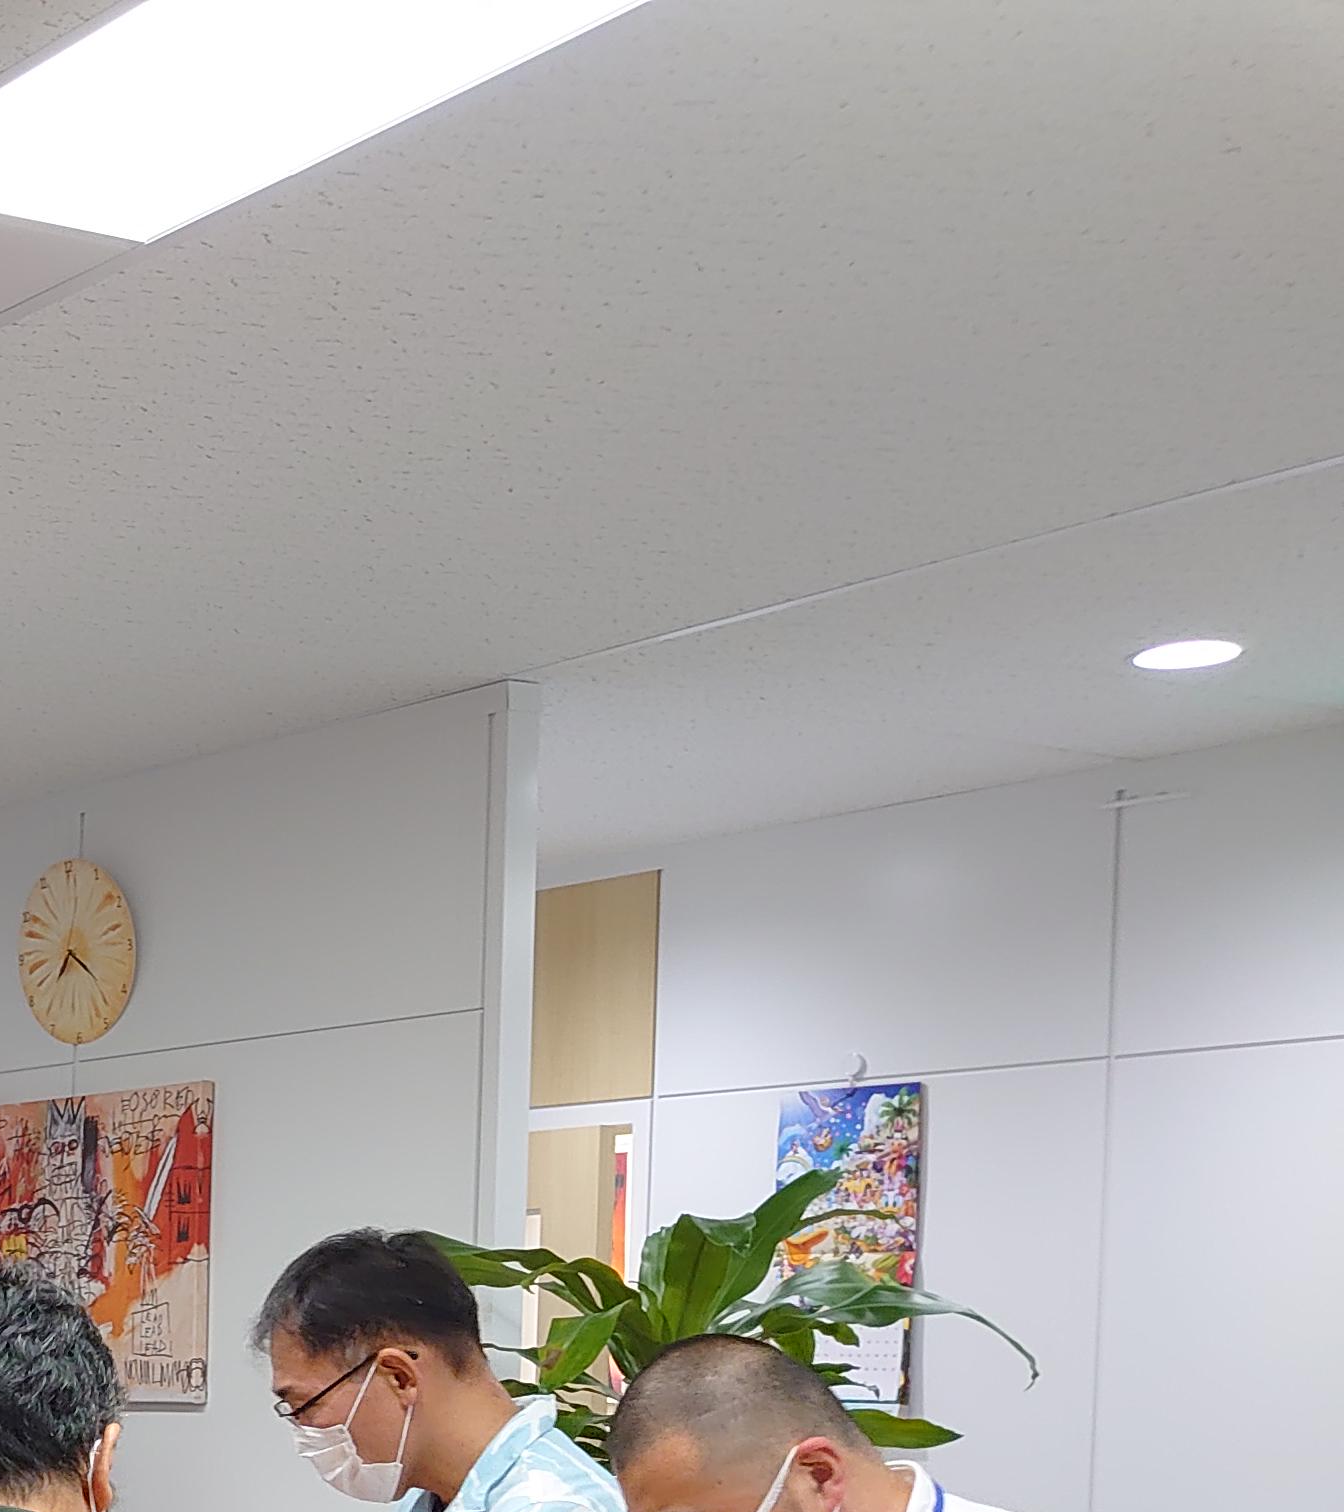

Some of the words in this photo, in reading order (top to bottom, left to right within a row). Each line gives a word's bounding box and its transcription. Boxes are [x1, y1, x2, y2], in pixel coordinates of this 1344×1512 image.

[63, 860, 73, 873] 12
[94, 868, 100, 880] 1
[116, 895, 123, 908] 2
[127, 938, 134, 951] 3
[120, 983, 128, 994] 4
[28, 995, 35, 1008] 8
[103, 1017, 110, 1030] 5
[76, 1032, 83, 1044] 6
